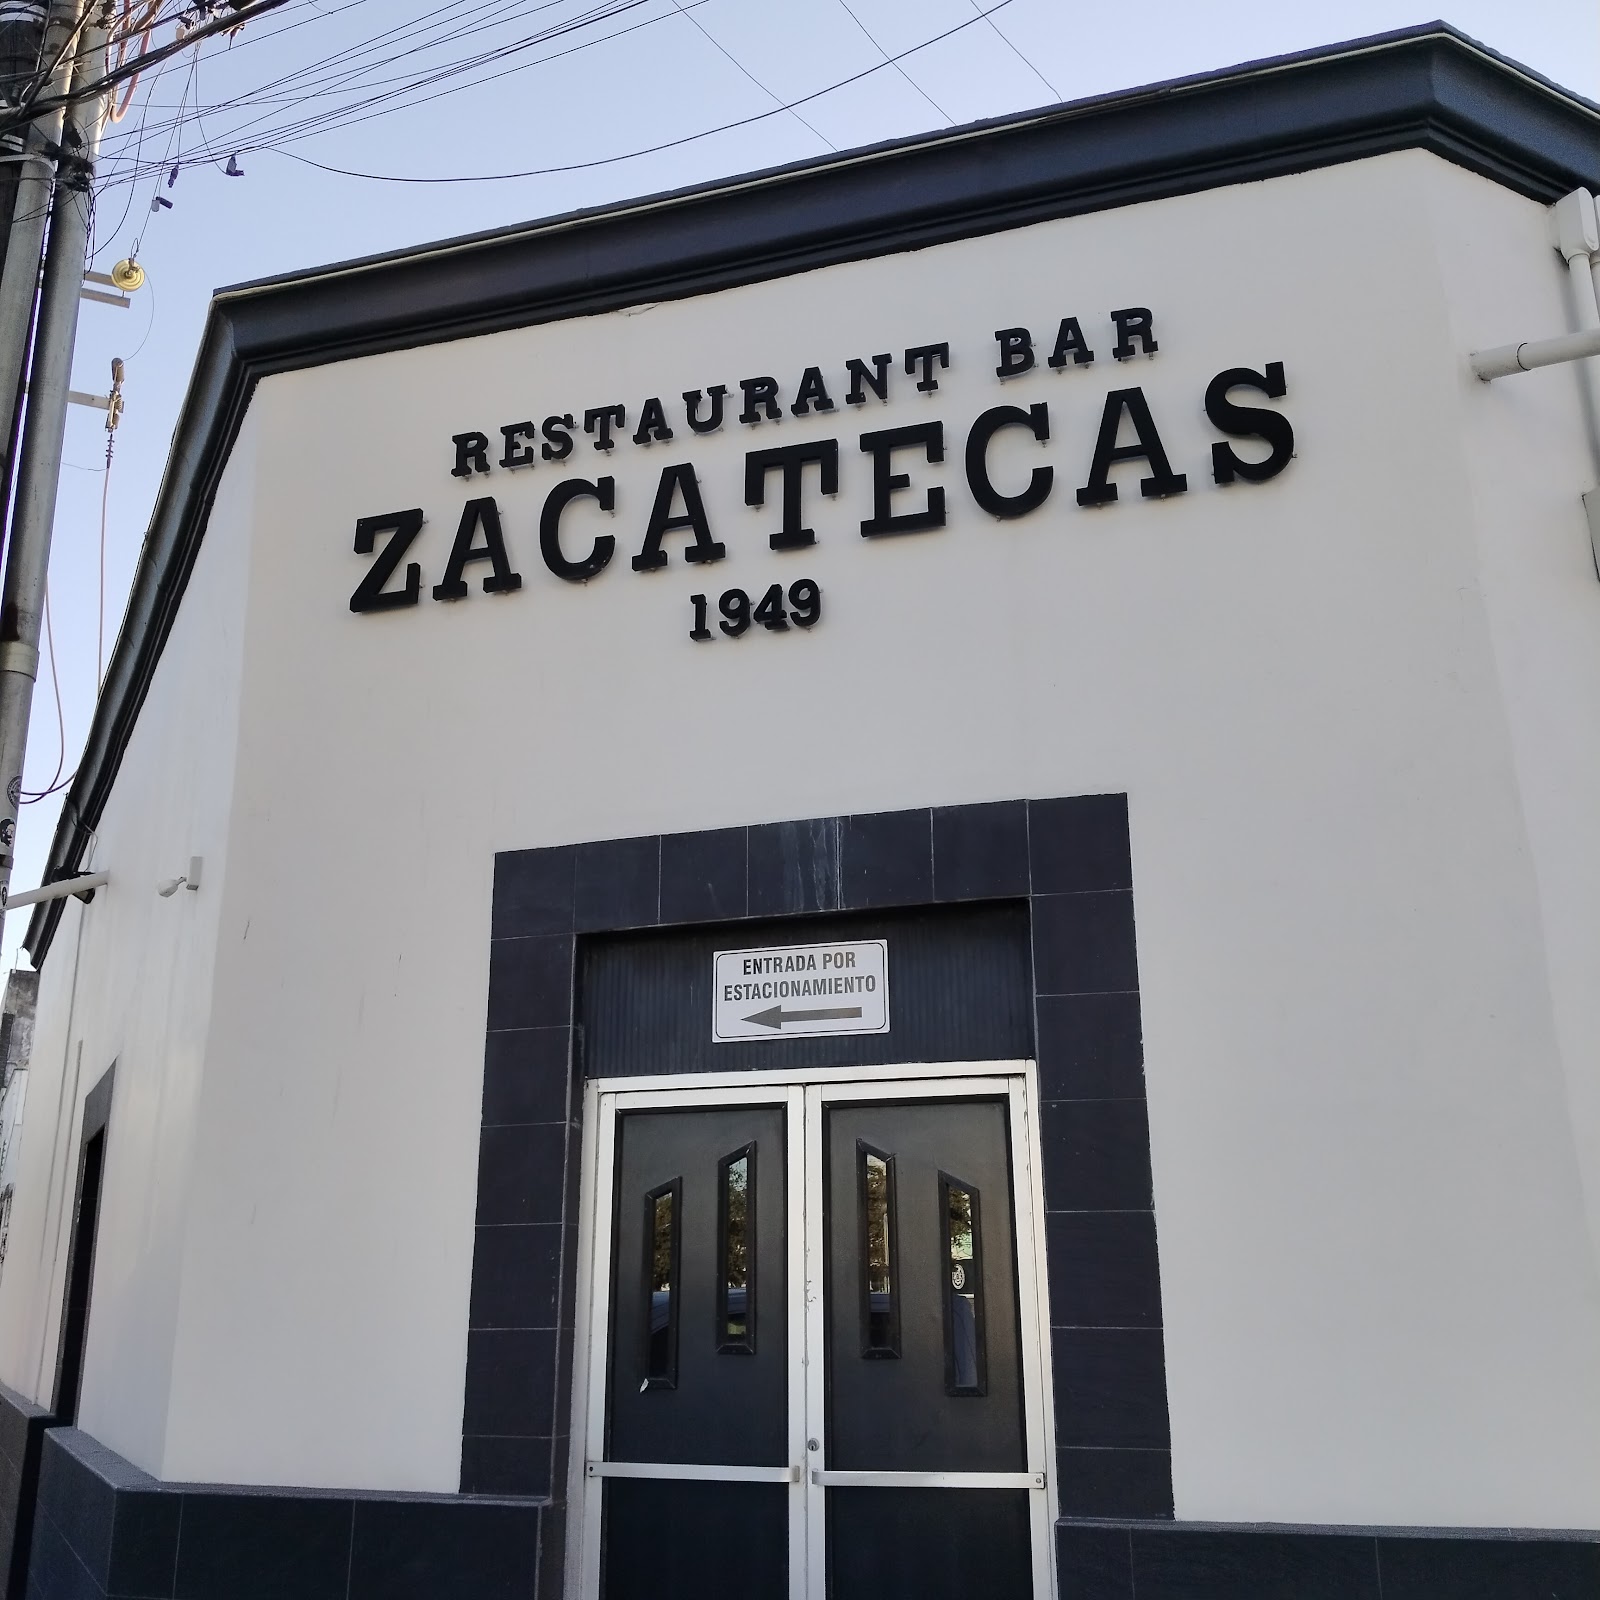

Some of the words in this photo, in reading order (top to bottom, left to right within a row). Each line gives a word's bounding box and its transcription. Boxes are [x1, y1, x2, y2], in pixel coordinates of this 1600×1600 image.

[451, 342, 949, 478] RESTAURANT
[995, 307, 1159, 378] BAR
[350, 361, 1296, 614] ZACATECAS
[690, 579, 820, 642] 1949
[724, 974, 876, 1002] ESTACIONAMIENTO
[743, 954, 817, 976] ENTRADA
[822, 951, 856, 971] POR
